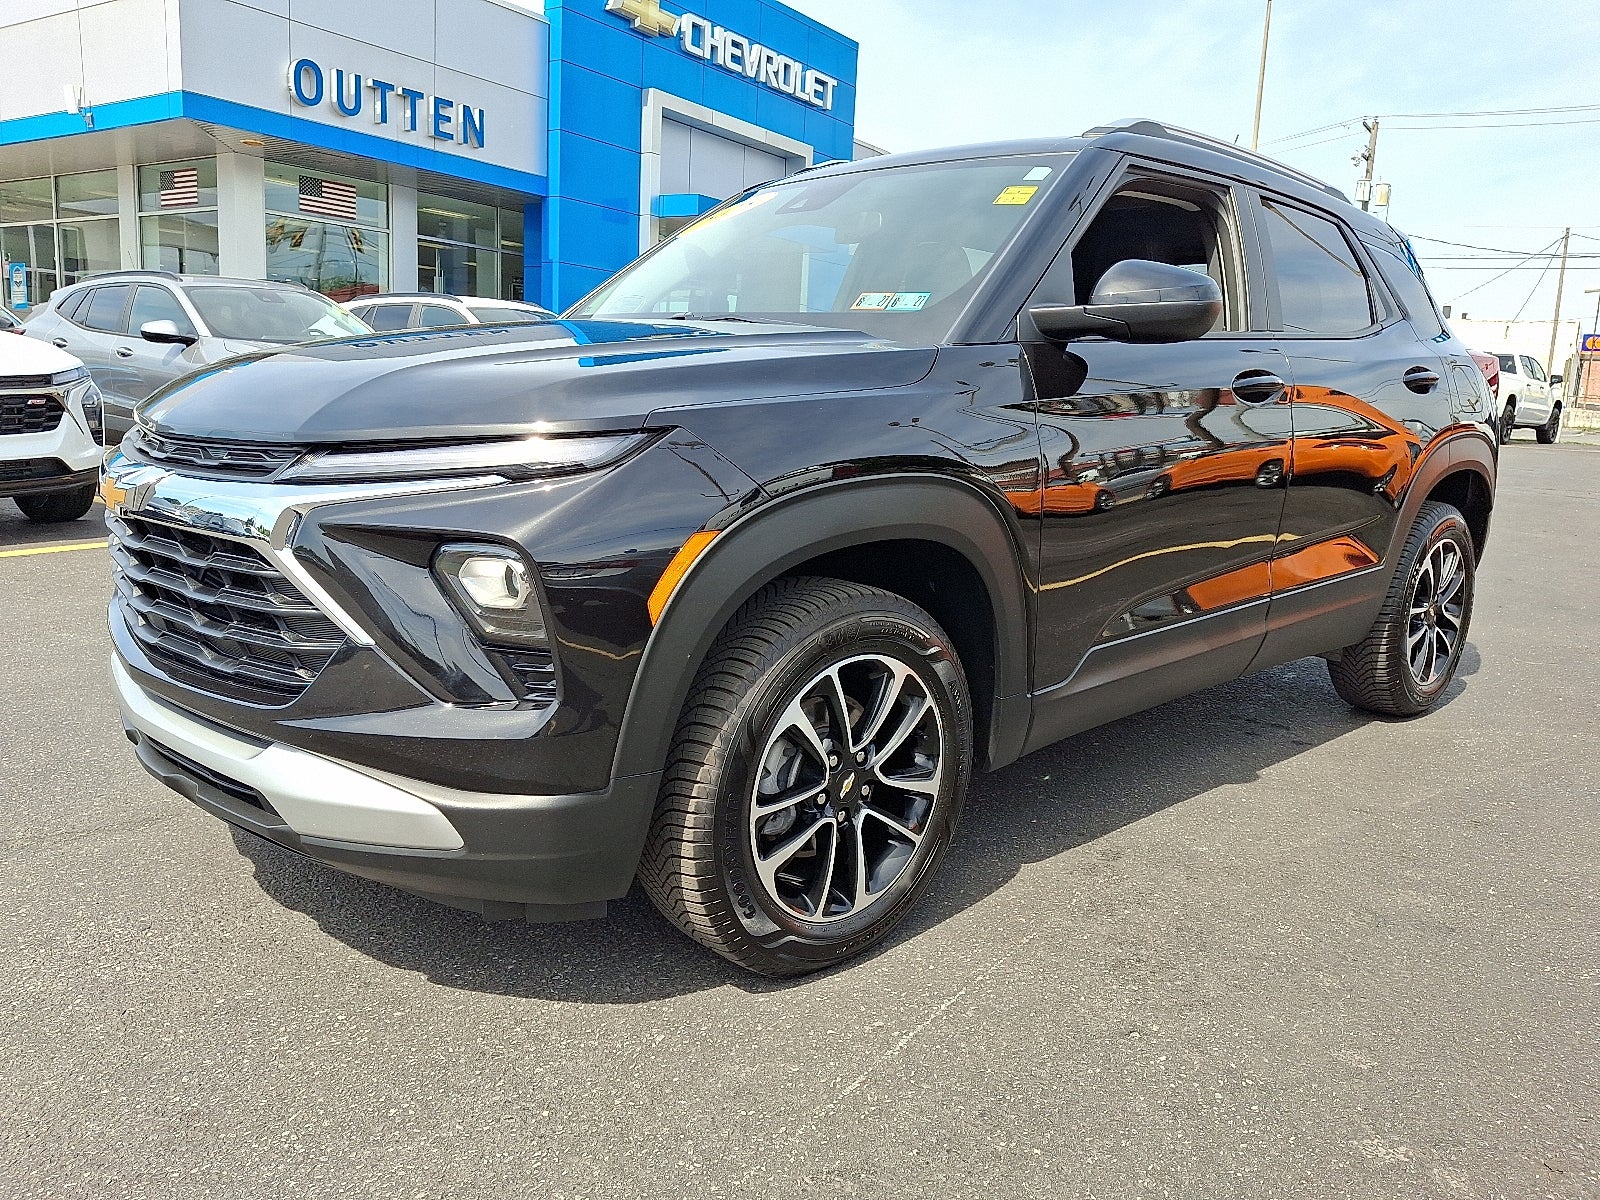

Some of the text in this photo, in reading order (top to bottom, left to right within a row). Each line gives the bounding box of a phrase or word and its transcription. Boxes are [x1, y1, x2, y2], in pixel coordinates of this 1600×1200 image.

[681, 12, 838, 111] CHEVROLET
[288, 58, 485, 149] OUTTEN
[876, 295, 891, 307] 27
[913, 296, 927, 307] 27
